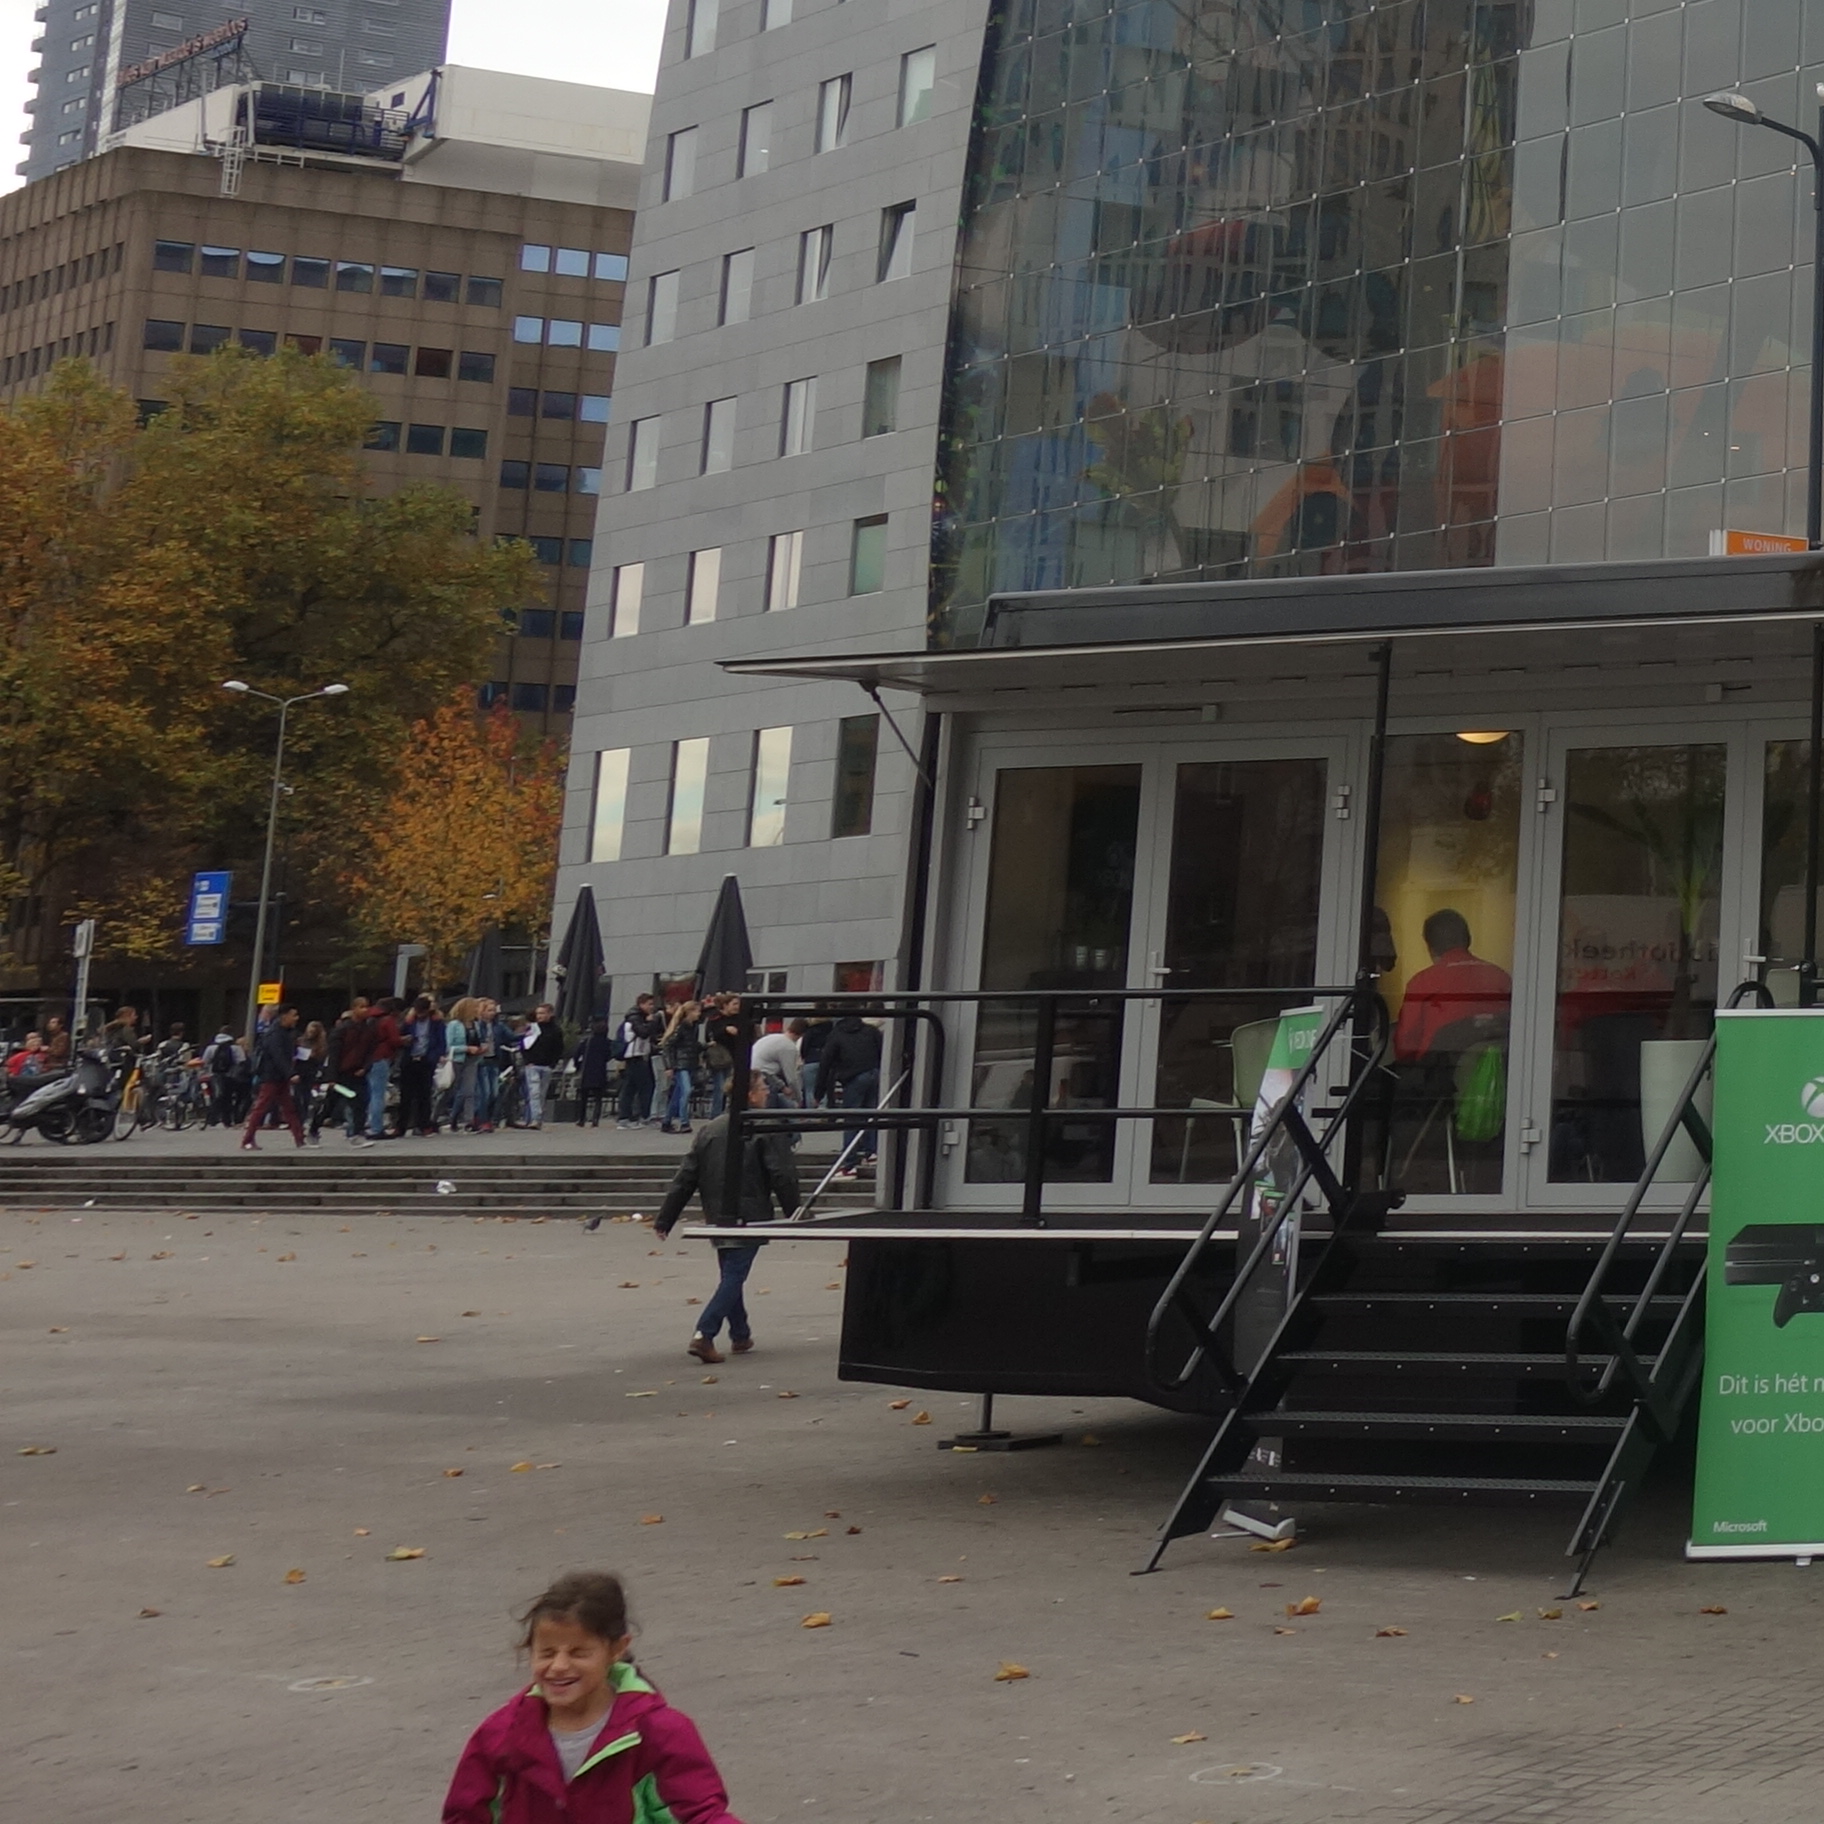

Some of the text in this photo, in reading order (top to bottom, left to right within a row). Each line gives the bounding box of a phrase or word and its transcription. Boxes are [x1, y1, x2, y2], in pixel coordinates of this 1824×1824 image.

[1743, 537, 1792, 552] WONING
[1719, 1375, 1748, 1394] Dit
[1754, 1375, 1769, 1393] is
[1775, 1373, 1808, 1393] hét
[1731, 1418, 1779, 1434] voor
[1713, 1519, 1768, 1533] Microsoft
